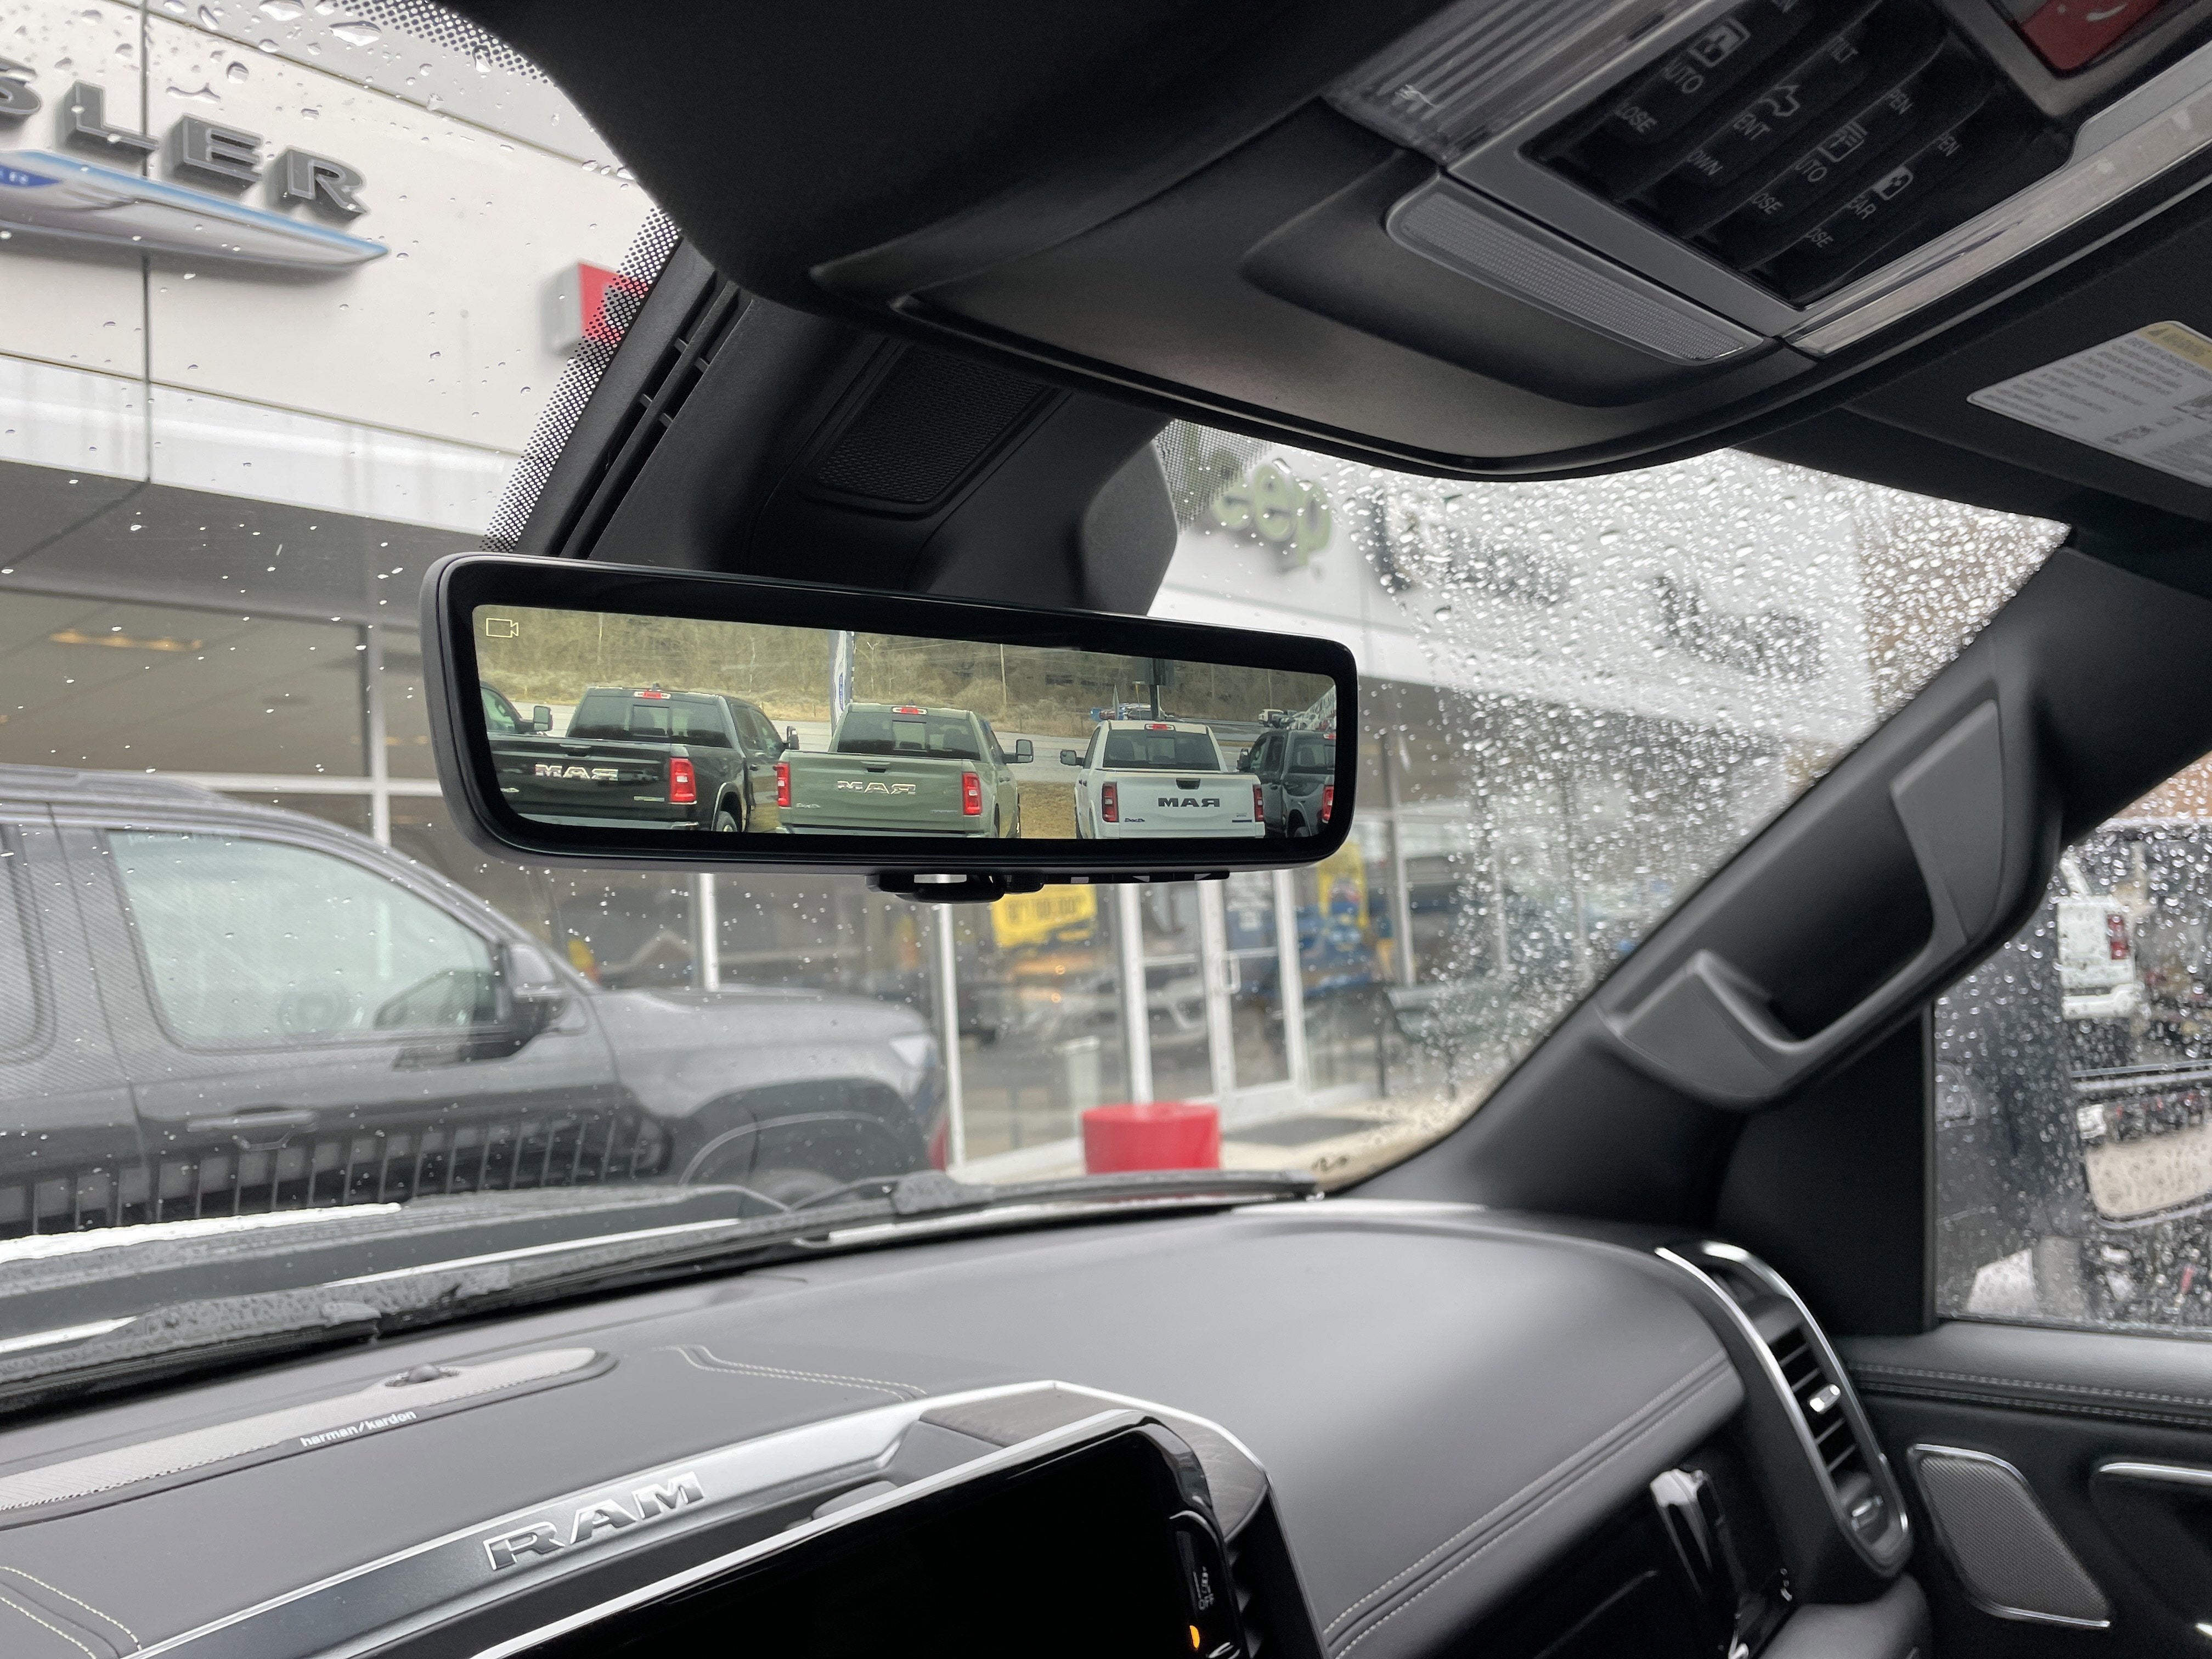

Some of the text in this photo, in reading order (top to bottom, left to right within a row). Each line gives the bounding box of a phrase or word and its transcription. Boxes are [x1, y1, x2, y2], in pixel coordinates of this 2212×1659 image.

[1733, 113, 1771, 140] ENT
[1795, 154, 1827, 183] UTO
[300, 1410, 417, 1447] harman/kardon
[482, 1471, 706, 1572] RAM
